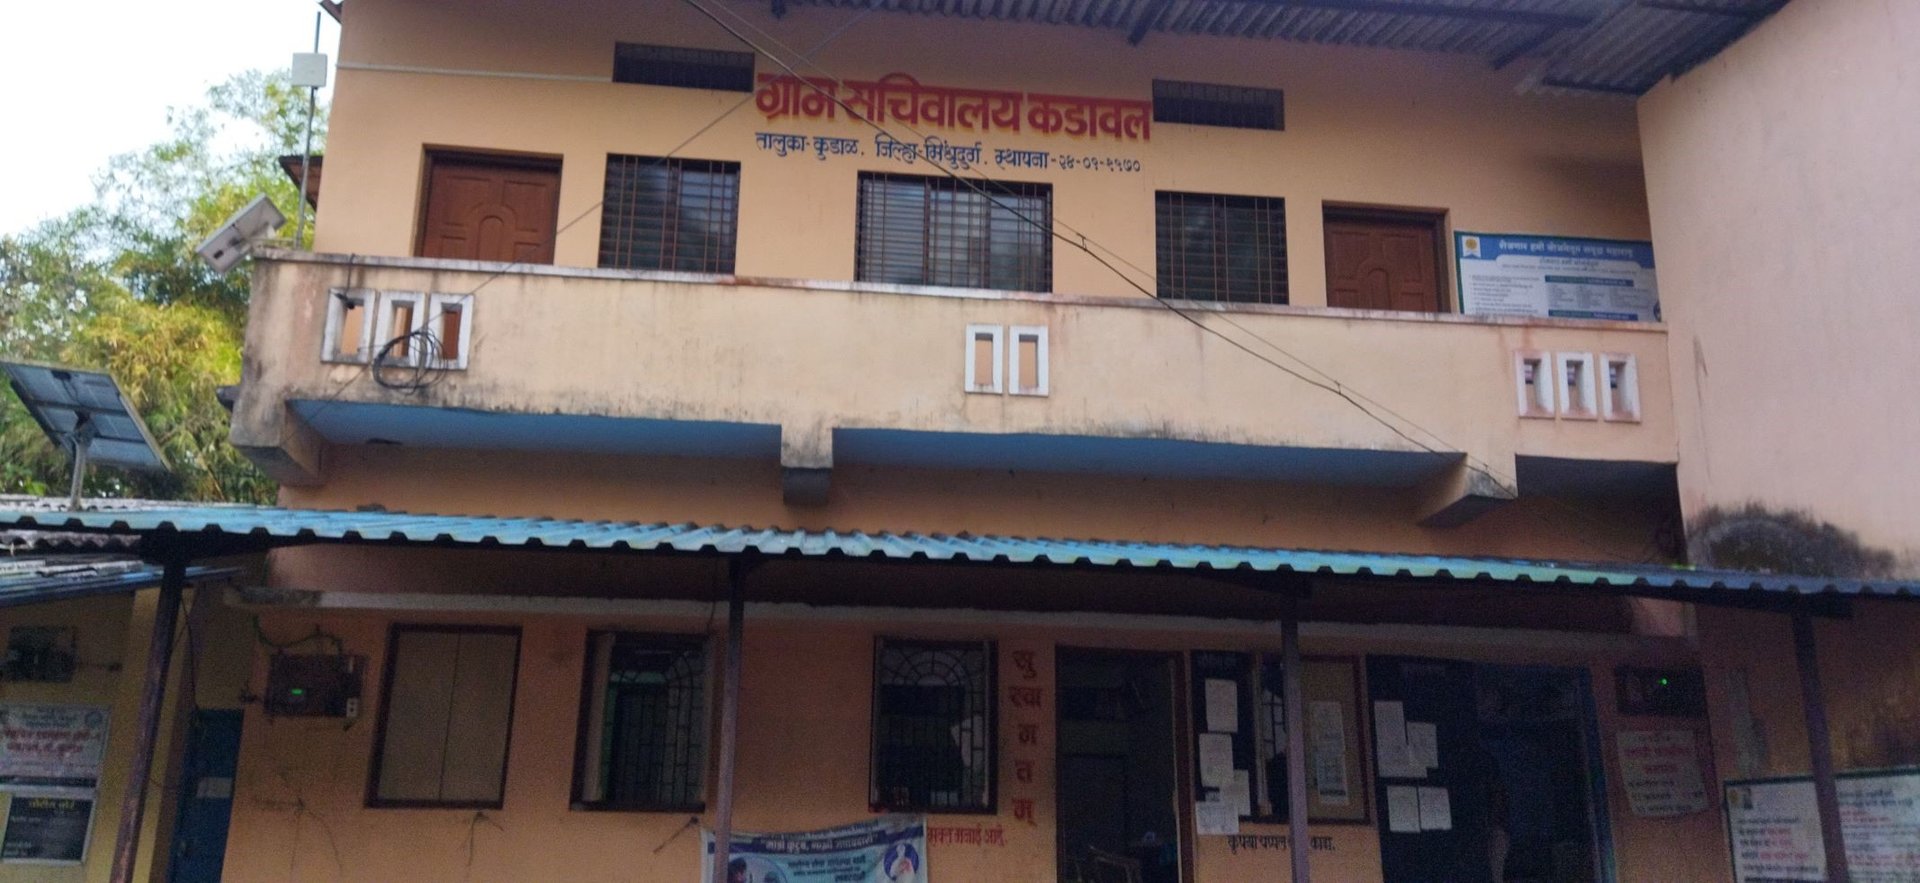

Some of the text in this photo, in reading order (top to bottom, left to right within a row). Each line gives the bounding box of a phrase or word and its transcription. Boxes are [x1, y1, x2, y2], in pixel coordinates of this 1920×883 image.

[756, 72, 1151, 140] ग्राम सचिवालय कडावल
